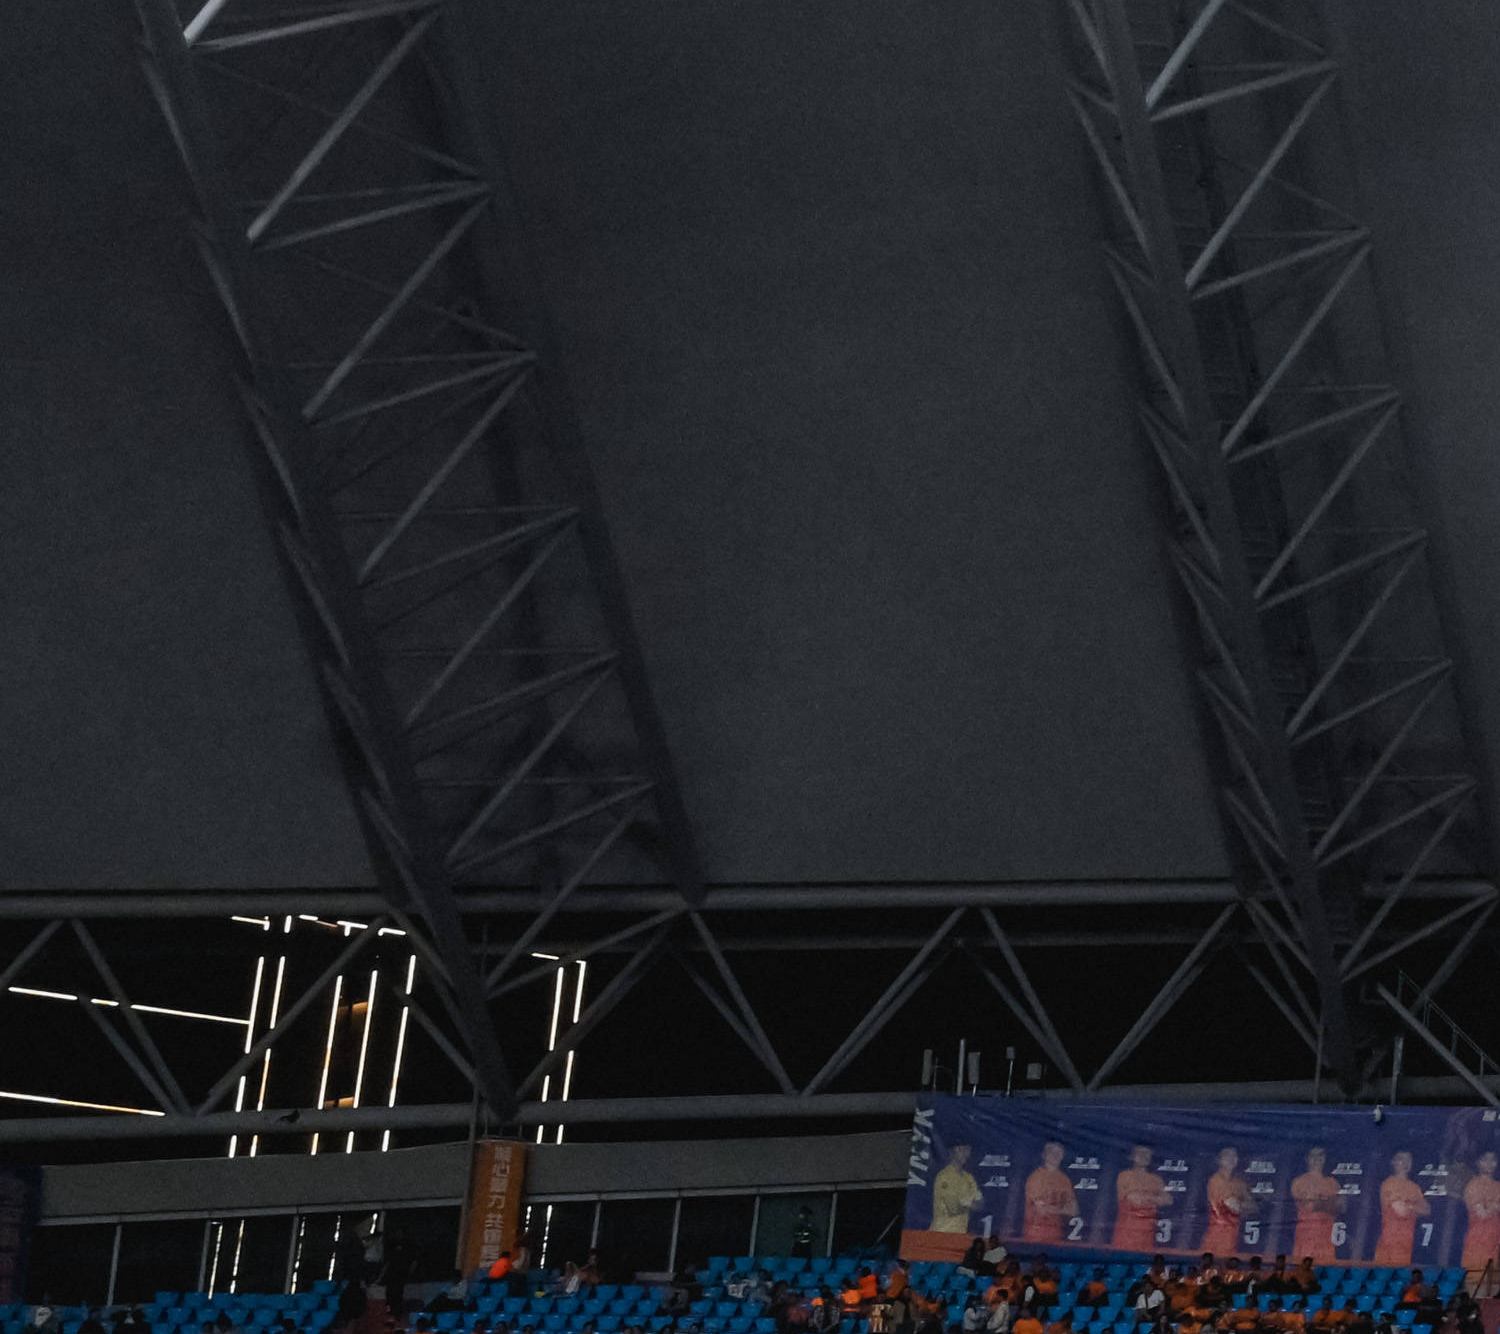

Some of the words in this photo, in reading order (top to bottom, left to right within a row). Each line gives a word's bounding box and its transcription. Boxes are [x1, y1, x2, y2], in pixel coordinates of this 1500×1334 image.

[981, 1215, 994, 1239] 1
[1068, 1217, 1085, 1240] 2
[1157, 1220, 1172, 1243] 3
[1244, 1221, 1260, 1244] 5
[1331, 1222, 1346, 1246] 6
[1421, 1223, 1433, 1246] 7
